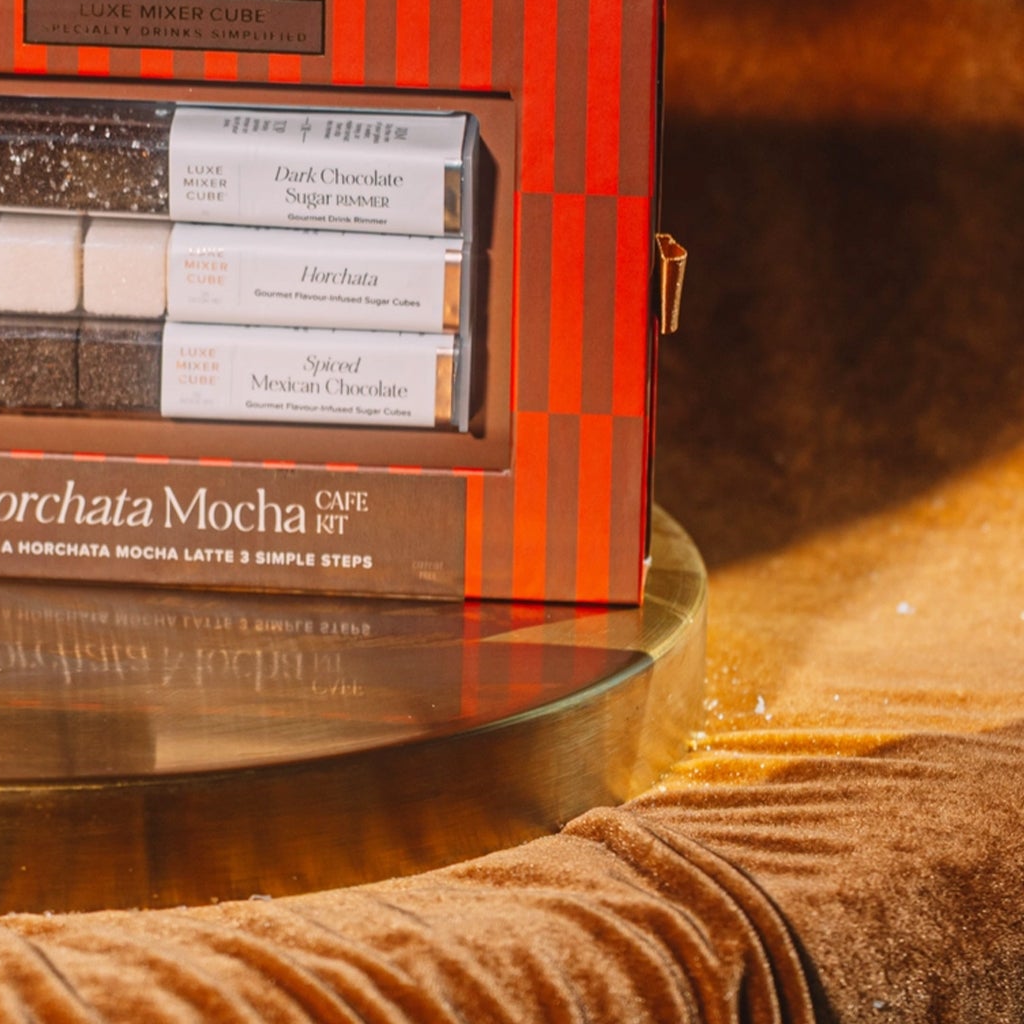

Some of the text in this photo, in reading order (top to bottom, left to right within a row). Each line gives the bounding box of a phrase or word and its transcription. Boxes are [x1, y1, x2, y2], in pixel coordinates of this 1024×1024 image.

[79, 3, 266, 23] LUXE MIXER CUBE
[140, 26, 202, 38] DRINKS
[211, 29, 306, 42] SIMPLIFIED
[187, 165, 223, 175] LUXE
[275, 166, 404, 187] Dark Chocolate
[183, 178, 227, 188] MIXER
[186, 191, 224, 202] CUBE
[285, 187, 390, 209] Sugar RIMMER
[287, 213, 388, 225] Gourmet Drink Rimmer
[183, 259, 229, 272] MIXER
[186, 273, 224, 286] CUBE
[300, 265, 379, 287] Horchata
[254, 288, 292, 299] Gourmet
[364, 296, 390, 307] Sugar
[392, 298, 421, 308] Cubes
[179, 347, 216, 358] LUXE
[176, 360, 219, 372] MIXER
[303, 353, 362, 377] Spiced
[178, 374, 216, 386] CUBE
[251, 373, 408, 398] Mexican Chocolate
[245, 399, 284, 410] Gourmet
[355, 406, 381, 417] Sugar
[383, 408, 412, 418] Cubes
[163, 485, 306, 534] Mocha
[315, 490, 369, 512] CAFE
[316, 514, 349, 535] KIT
[1, 540, 13, 554] A
[18, 541, 110, 558] HORCHATA
[115, 545, 178, 561] MOCHA
[183, 548, 234, 563] LATTE
[240, 550, 250, 564] 3
[255, 550, 315, 567] SIMPLE
[320, 553, 373, 569] STEPS
